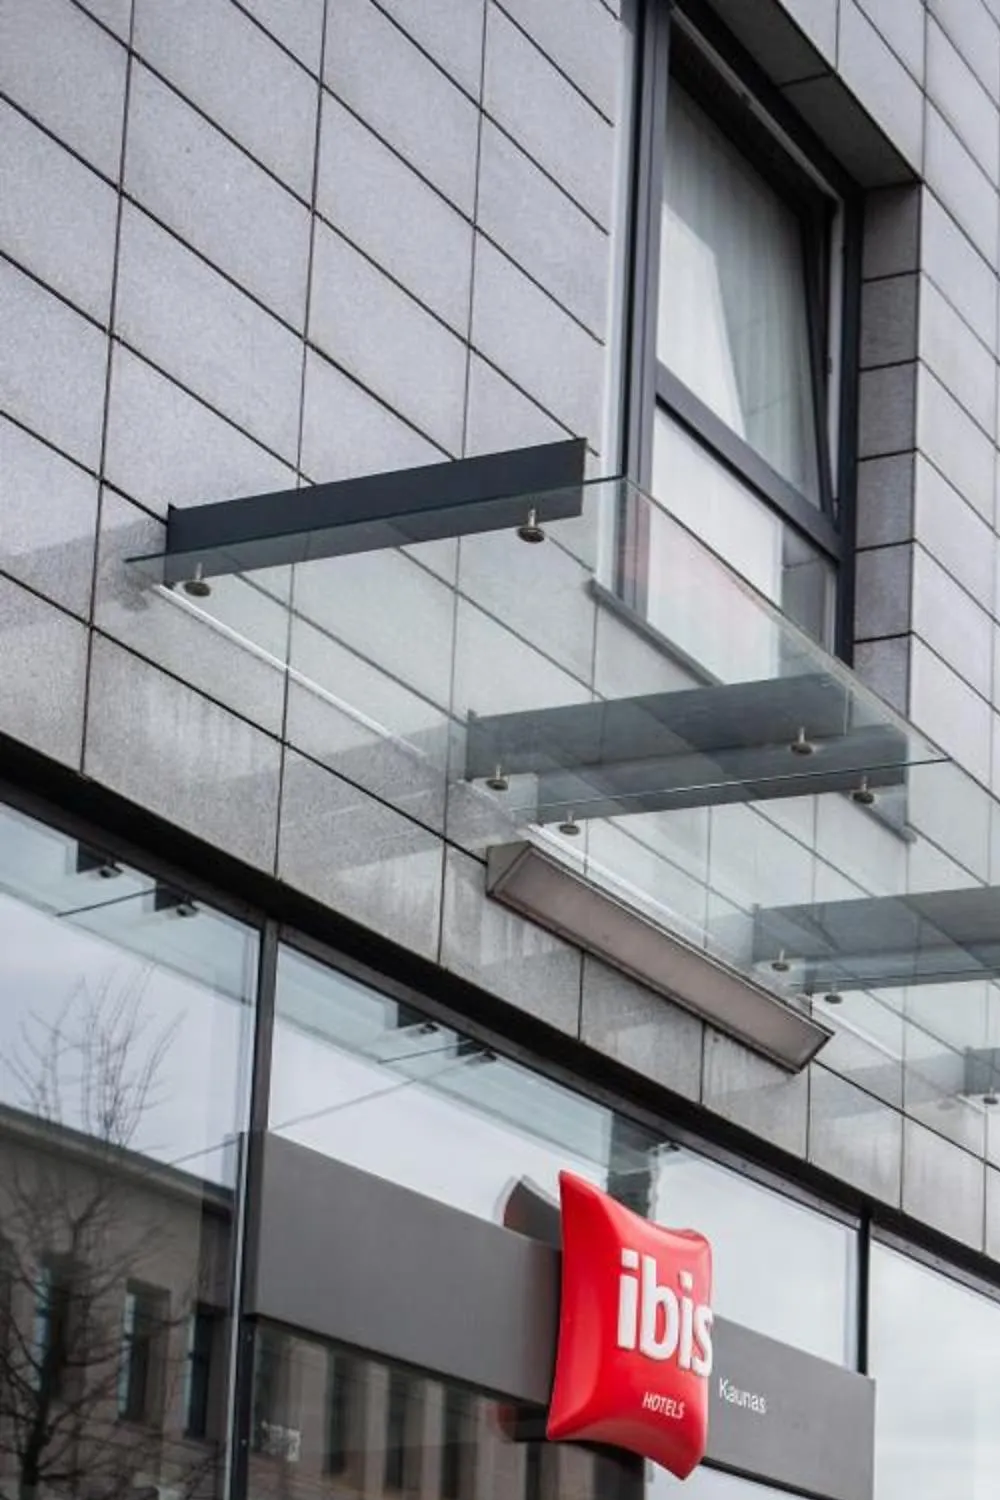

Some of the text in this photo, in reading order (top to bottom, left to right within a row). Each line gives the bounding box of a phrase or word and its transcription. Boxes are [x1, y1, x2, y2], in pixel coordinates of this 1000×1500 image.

[616, 1247, 714, 1378] ibis
[642, 1391, 686, 1420] HOTELS
[718, 1377, 767, 1414] Kaunas
